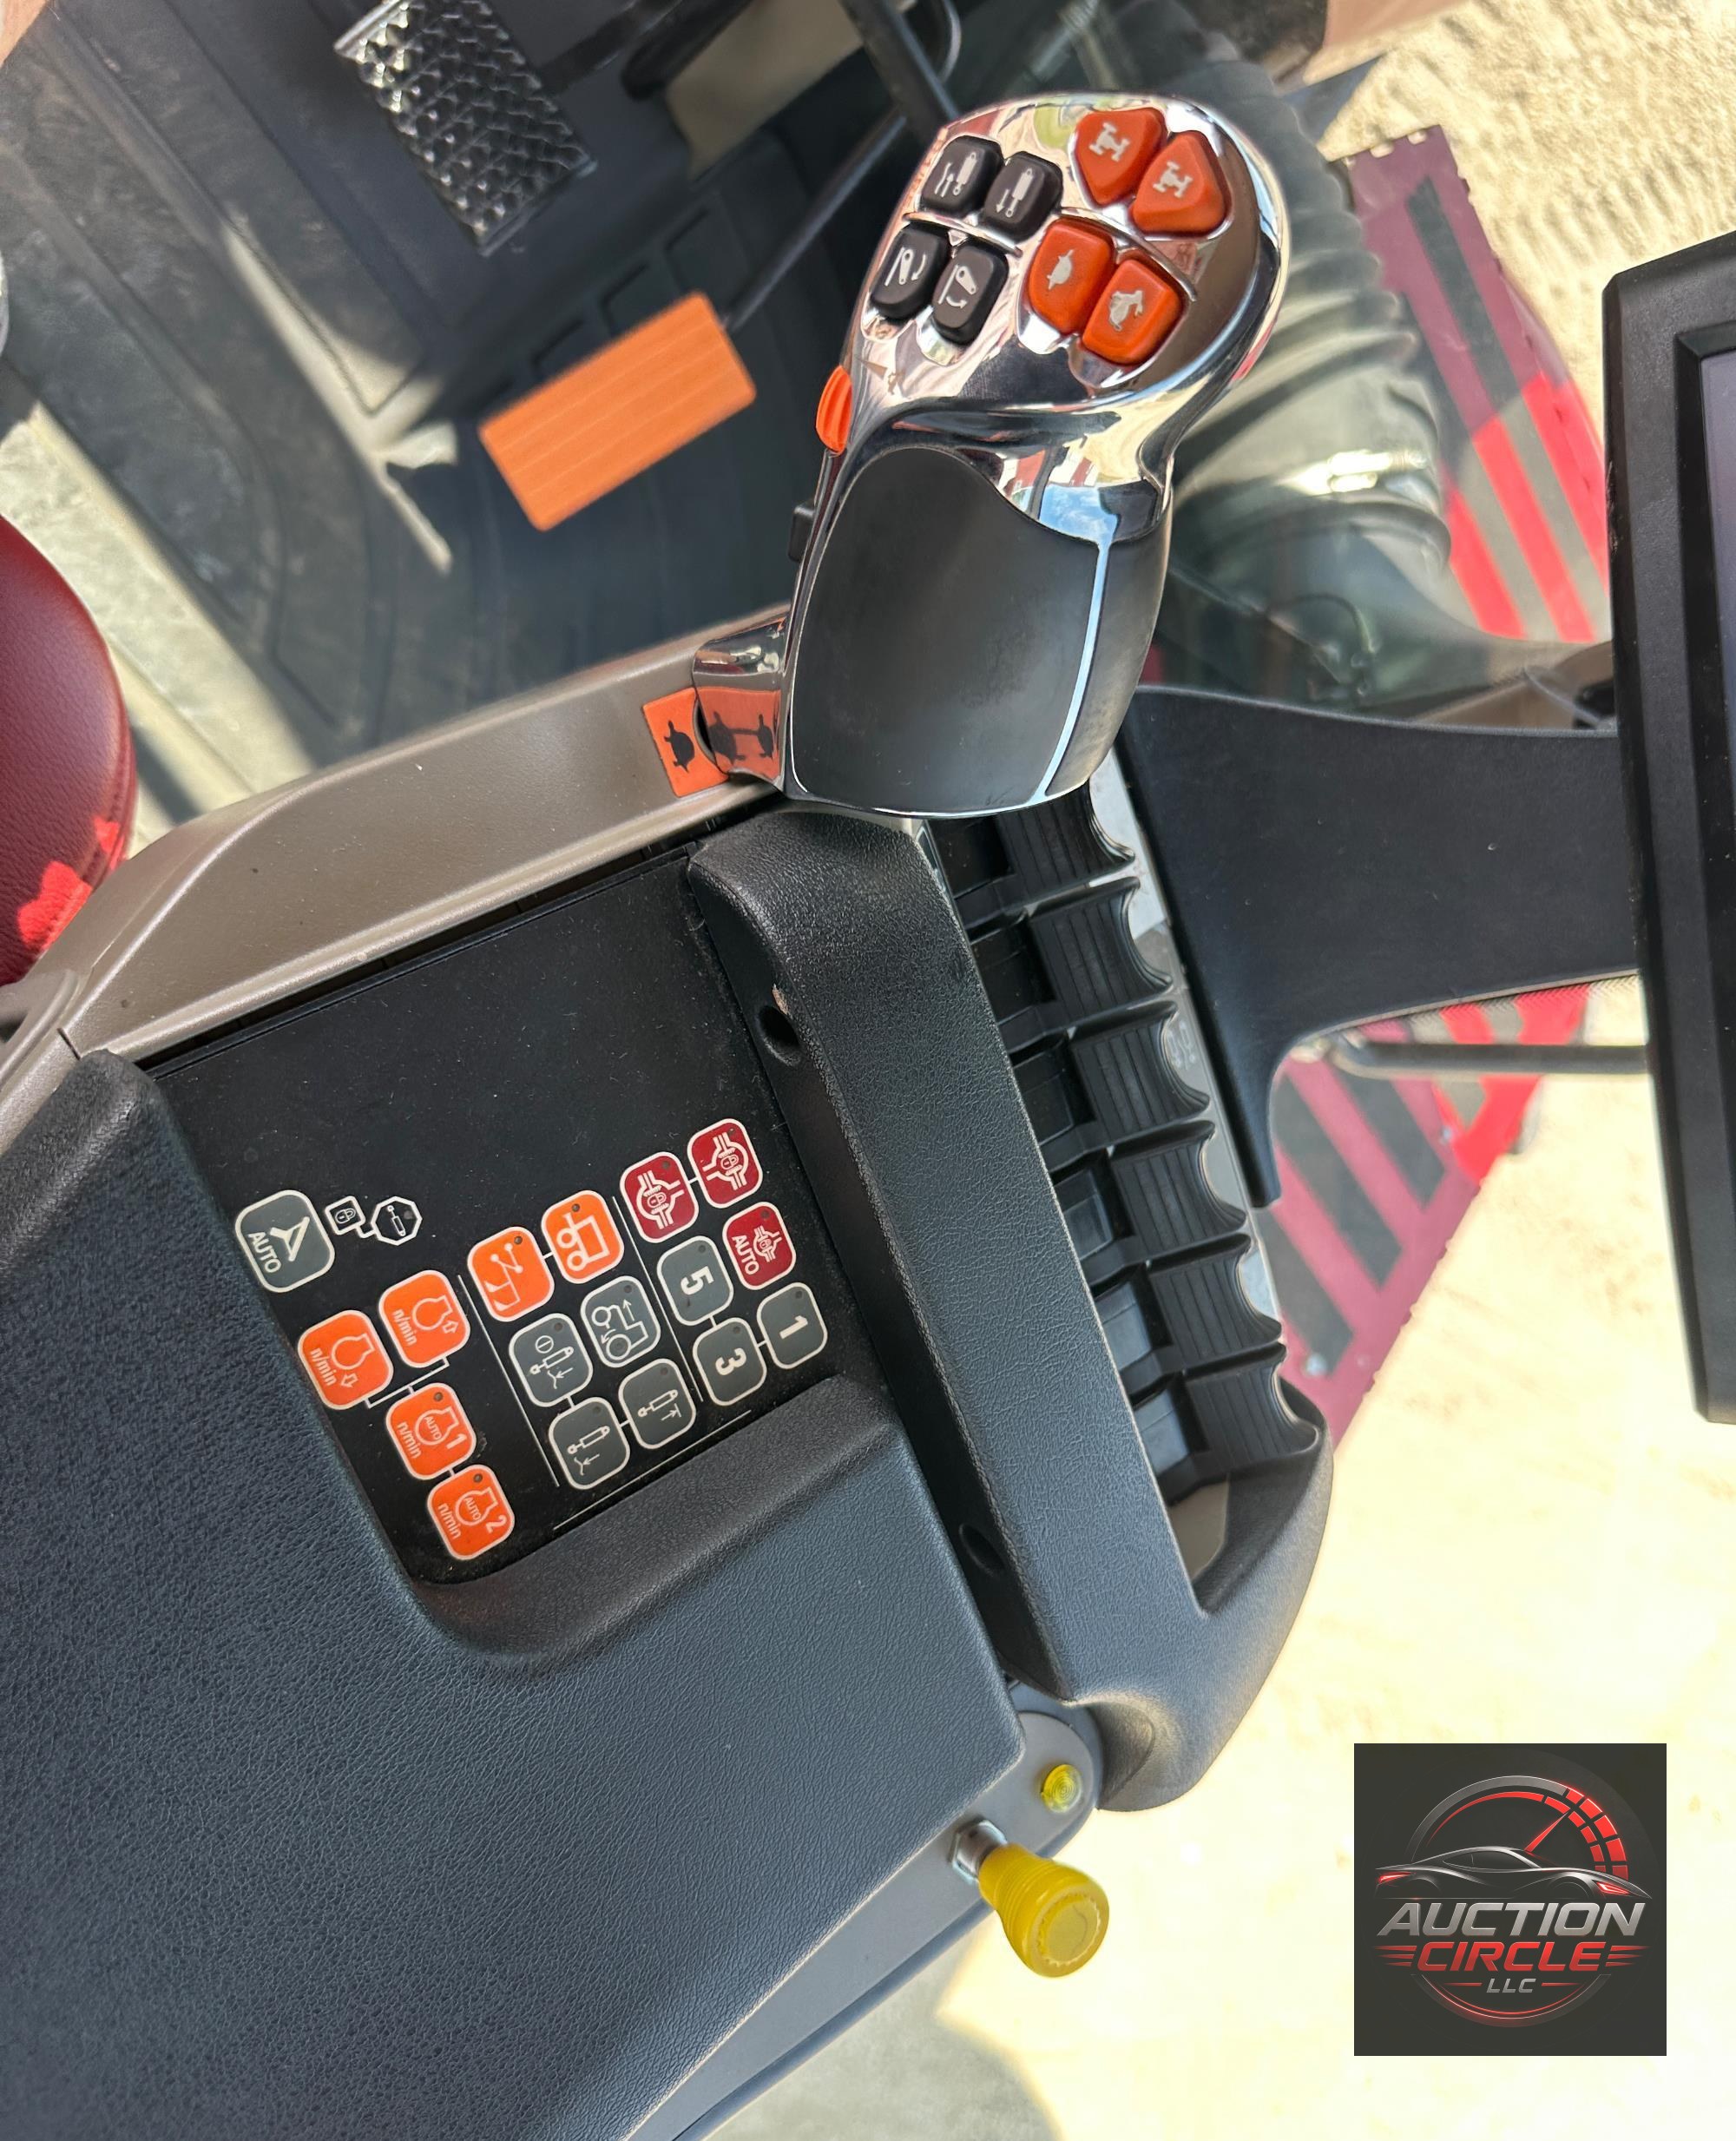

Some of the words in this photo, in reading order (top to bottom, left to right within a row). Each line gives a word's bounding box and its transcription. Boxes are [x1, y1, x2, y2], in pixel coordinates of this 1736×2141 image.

[247, 1231, 281, 1274] AUTO
[732, 1235, 760, 1275] AUTO
[680, 1266, 714, 1295] 5
[391, 1308, 417, 1347] n/min
[779, 1315, 809, 1339] 1
[309, 1347, 337, 1387] n/min
[715, 1347, 747, 1376] 3
[397, 1421, 422, 1459] n/min
[424, 1415, 443, 1441] AUTO
[446, 1433, 466, 1450] 1
[437, 1503, 462, 1539] n/min
[464, 1497, 483, 1521] AUTO
[485, 1514, 506, 1533] 2
